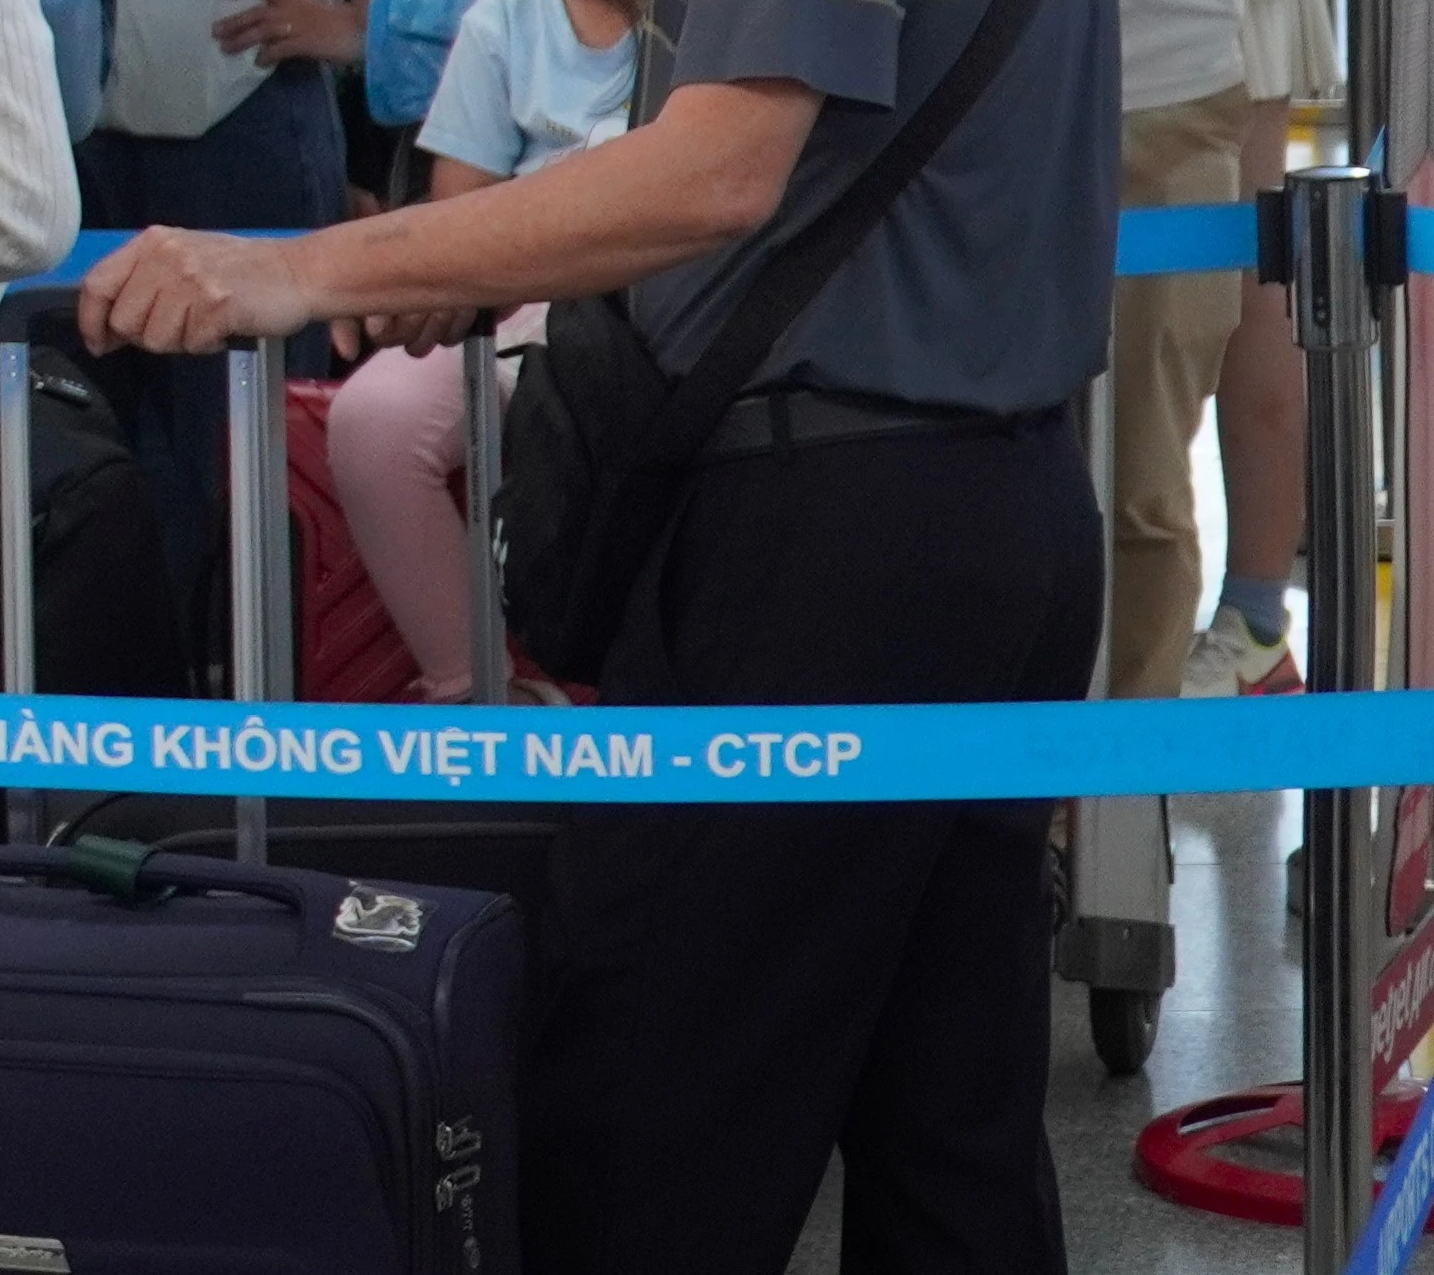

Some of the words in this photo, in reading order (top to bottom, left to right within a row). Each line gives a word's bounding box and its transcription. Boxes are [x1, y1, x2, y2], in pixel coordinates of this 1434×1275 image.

[152, 715, 361, 774] KHÔNG
[377, 728, 507, 787] VIỆT
[524, 733, 654, 777] NAM
[707, 732, 862, 778] CTCP
